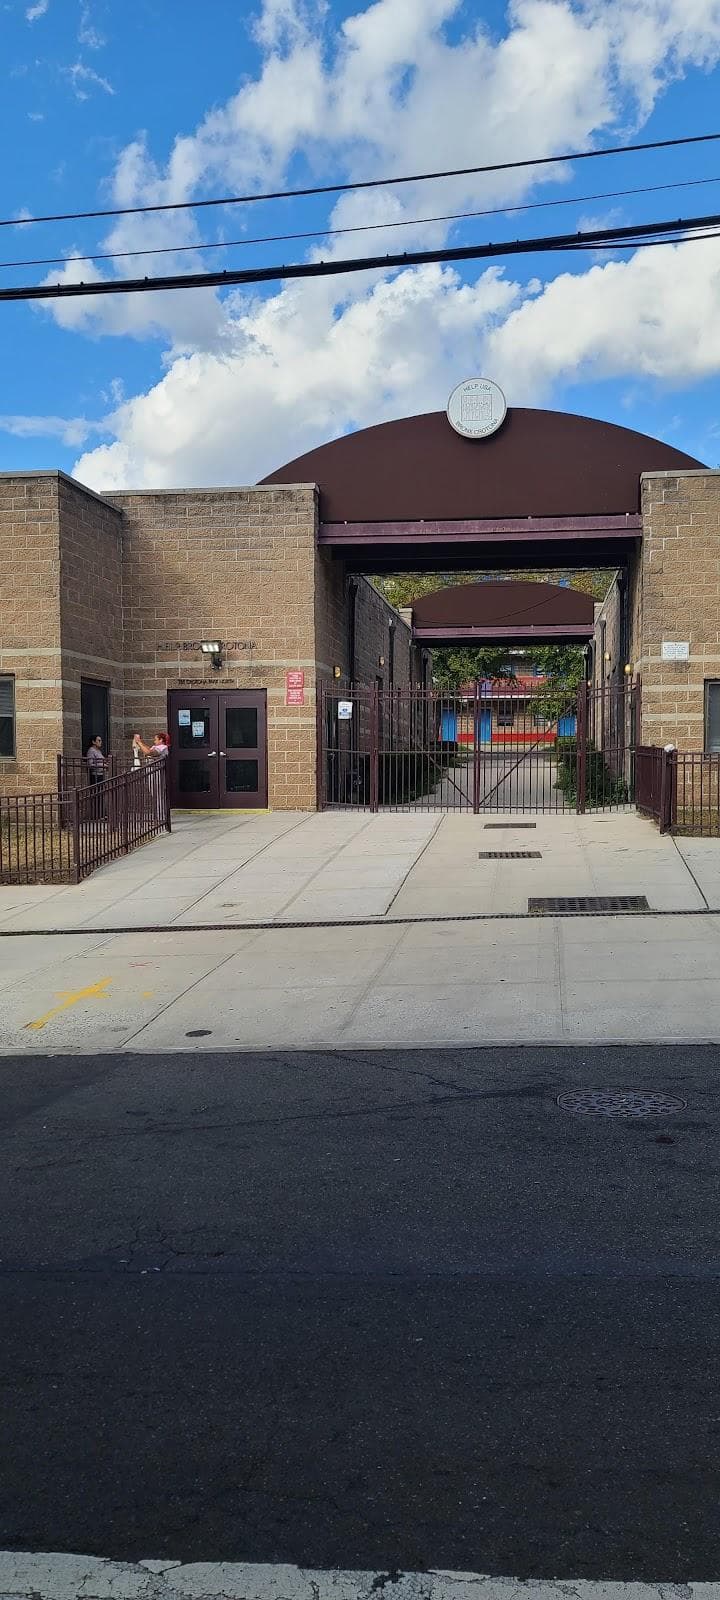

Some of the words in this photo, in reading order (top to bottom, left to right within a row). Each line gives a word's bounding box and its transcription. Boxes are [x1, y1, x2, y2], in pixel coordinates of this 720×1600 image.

[463, 384, 479, 392] HELP
[480, 383, 492, 391] USA
[183, 641, 202, 651] BRO
[219, 641, 258, 651] ROTONA
